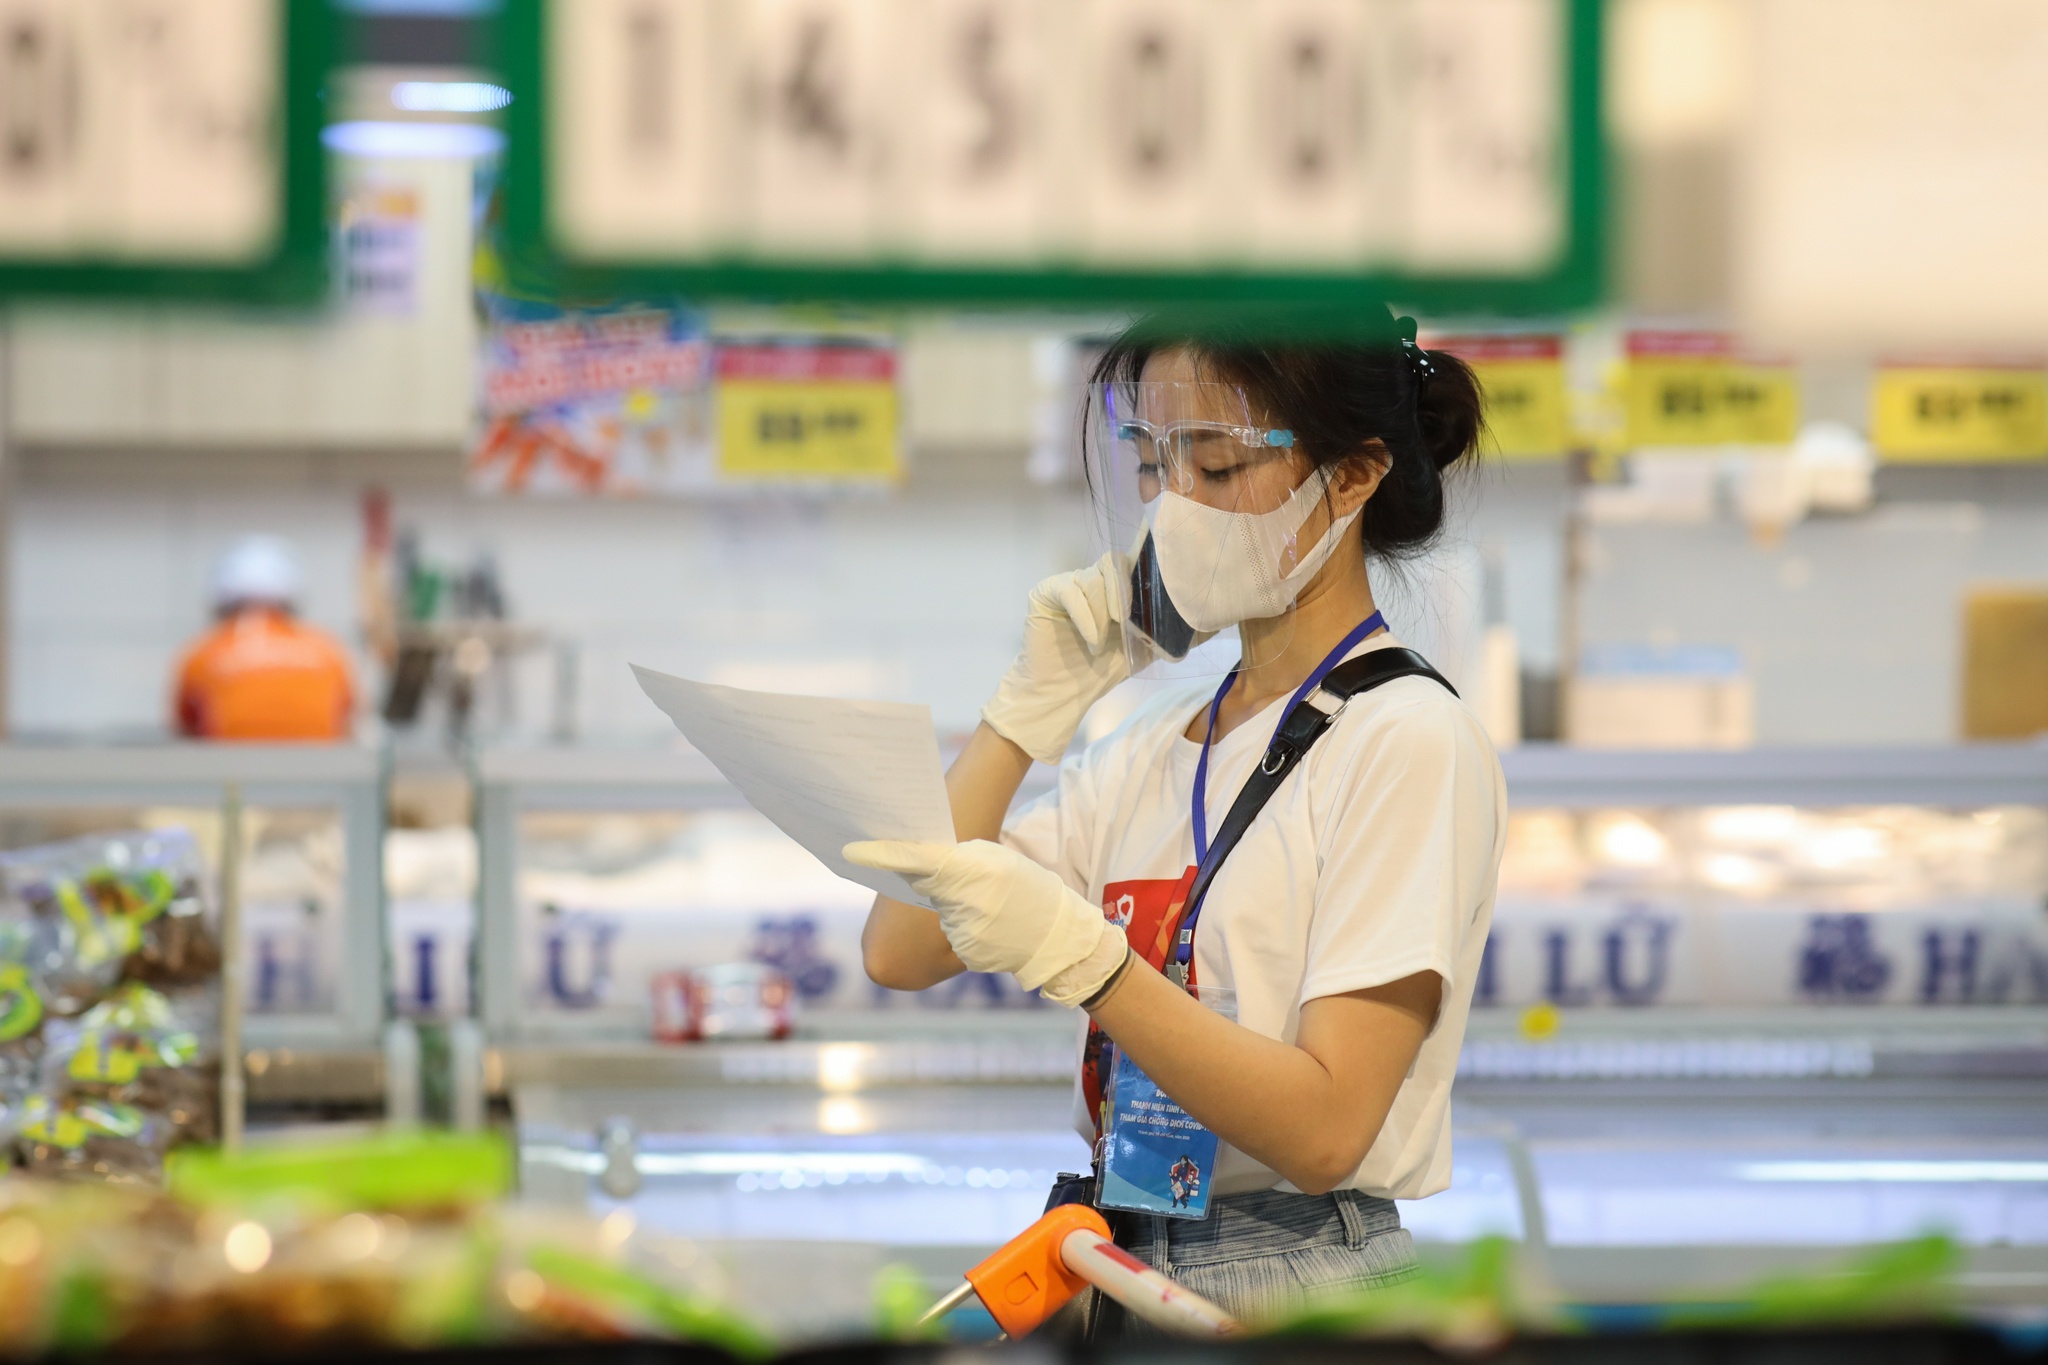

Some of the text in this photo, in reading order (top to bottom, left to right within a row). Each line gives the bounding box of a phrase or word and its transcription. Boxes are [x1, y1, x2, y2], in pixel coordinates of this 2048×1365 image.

[1131, 1100, 1151, 1110] THANH
[1120, 1113, 1136, 1122] THAM
[1137, 1115, 1148, 1123] GIA
[1170, 1119, 1184, 1129] DỊCH
